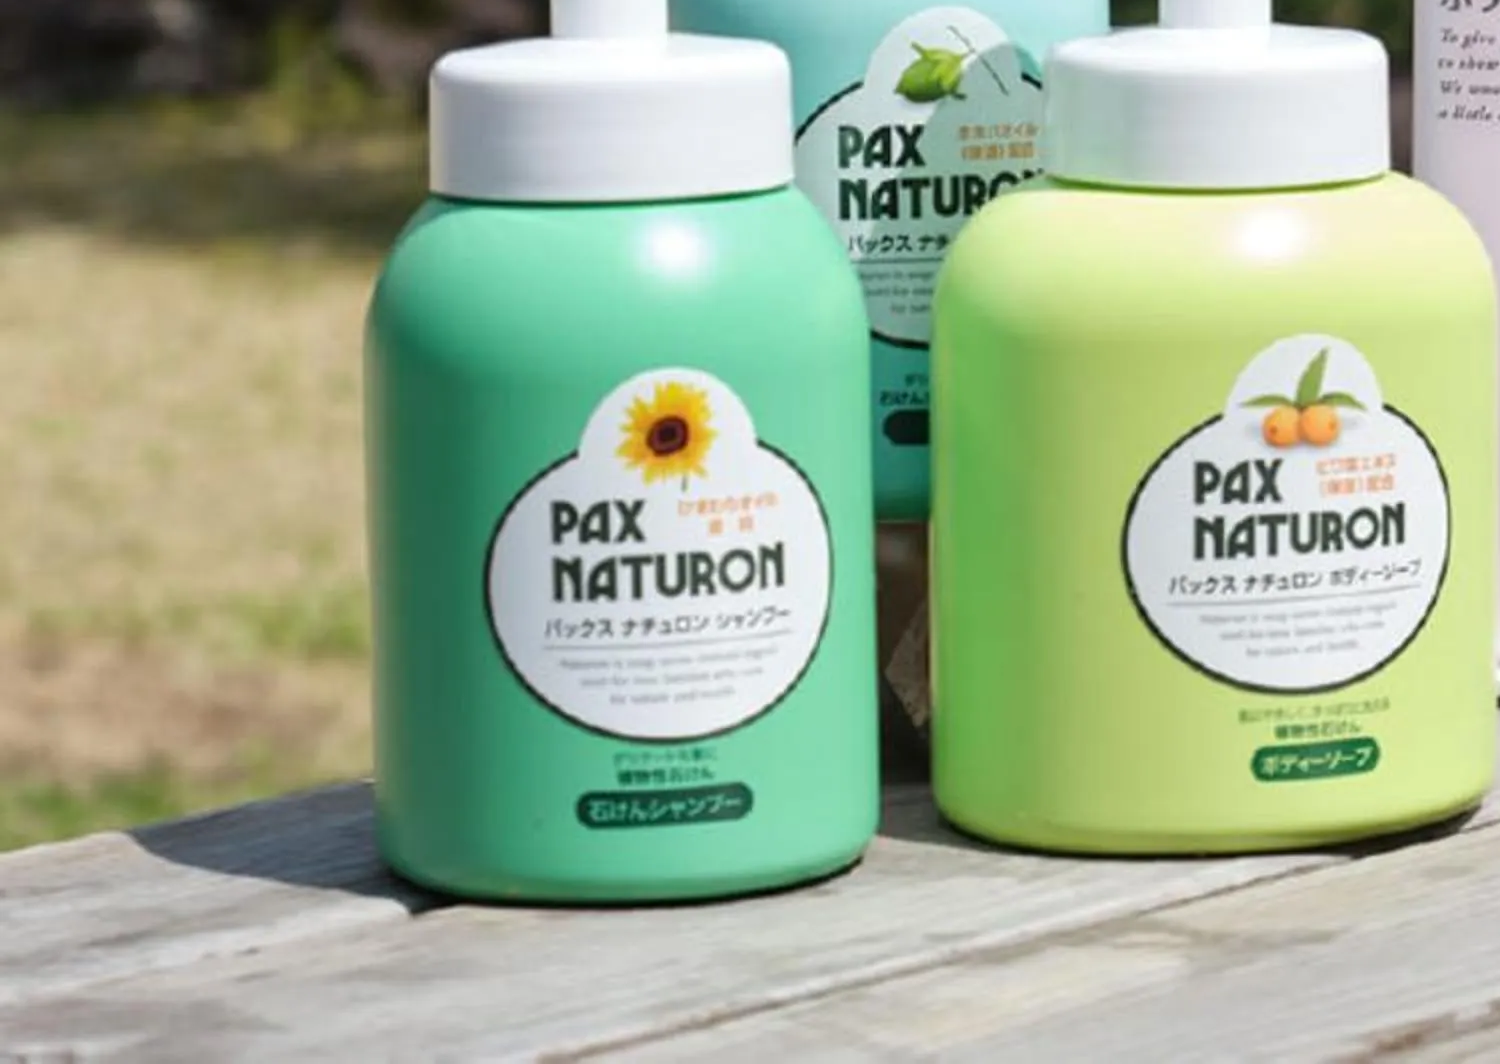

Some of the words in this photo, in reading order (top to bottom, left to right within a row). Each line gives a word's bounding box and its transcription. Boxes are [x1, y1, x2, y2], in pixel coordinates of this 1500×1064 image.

[838, 125, 926, 169] PAX
[838, 169, 1044, 221] NATUR
[1193, 458, 1283, 506] PAX
[550, 498, 647, 545] PAX
[1193, 501, 1406, 563] NATURON
[551, 541, 786, 605] NATURON
[1243, 570, 1323, 593] ナチュロン
[620, 614, 712, 638] ナチュロン
